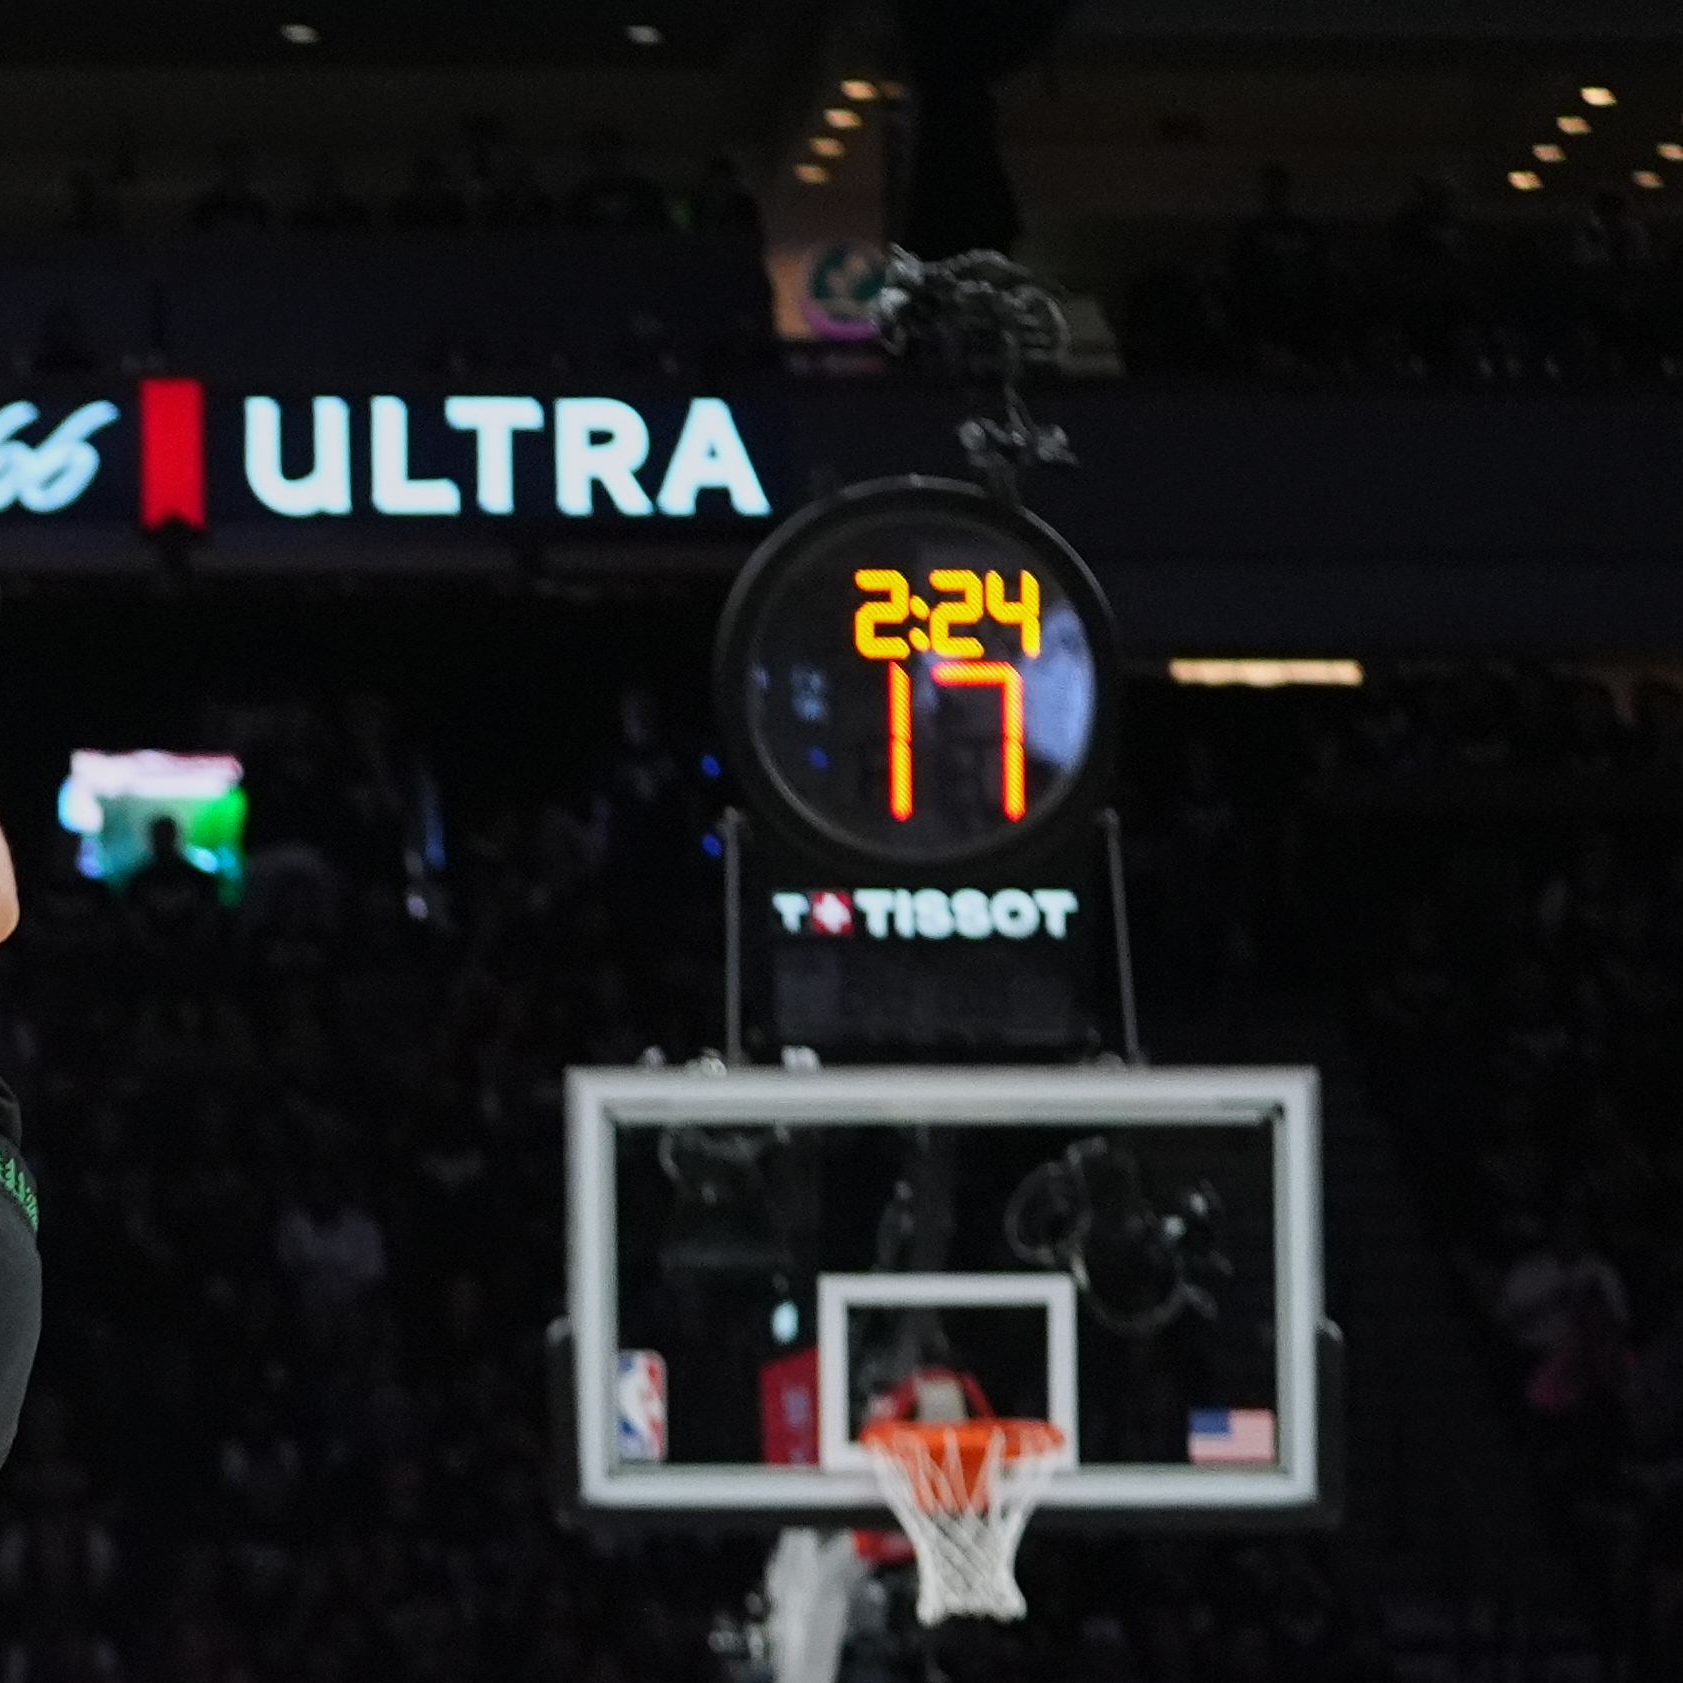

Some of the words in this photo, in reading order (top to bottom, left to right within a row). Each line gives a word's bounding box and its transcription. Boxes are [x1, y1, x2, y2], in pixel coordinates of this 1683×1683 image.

[244, 395, 771, 517] ULTRA
[854, 568, 1042, 660] 2:24
[887, 660, 1027, 822] 17
[852, 888, 1079, 939] TISSOT
